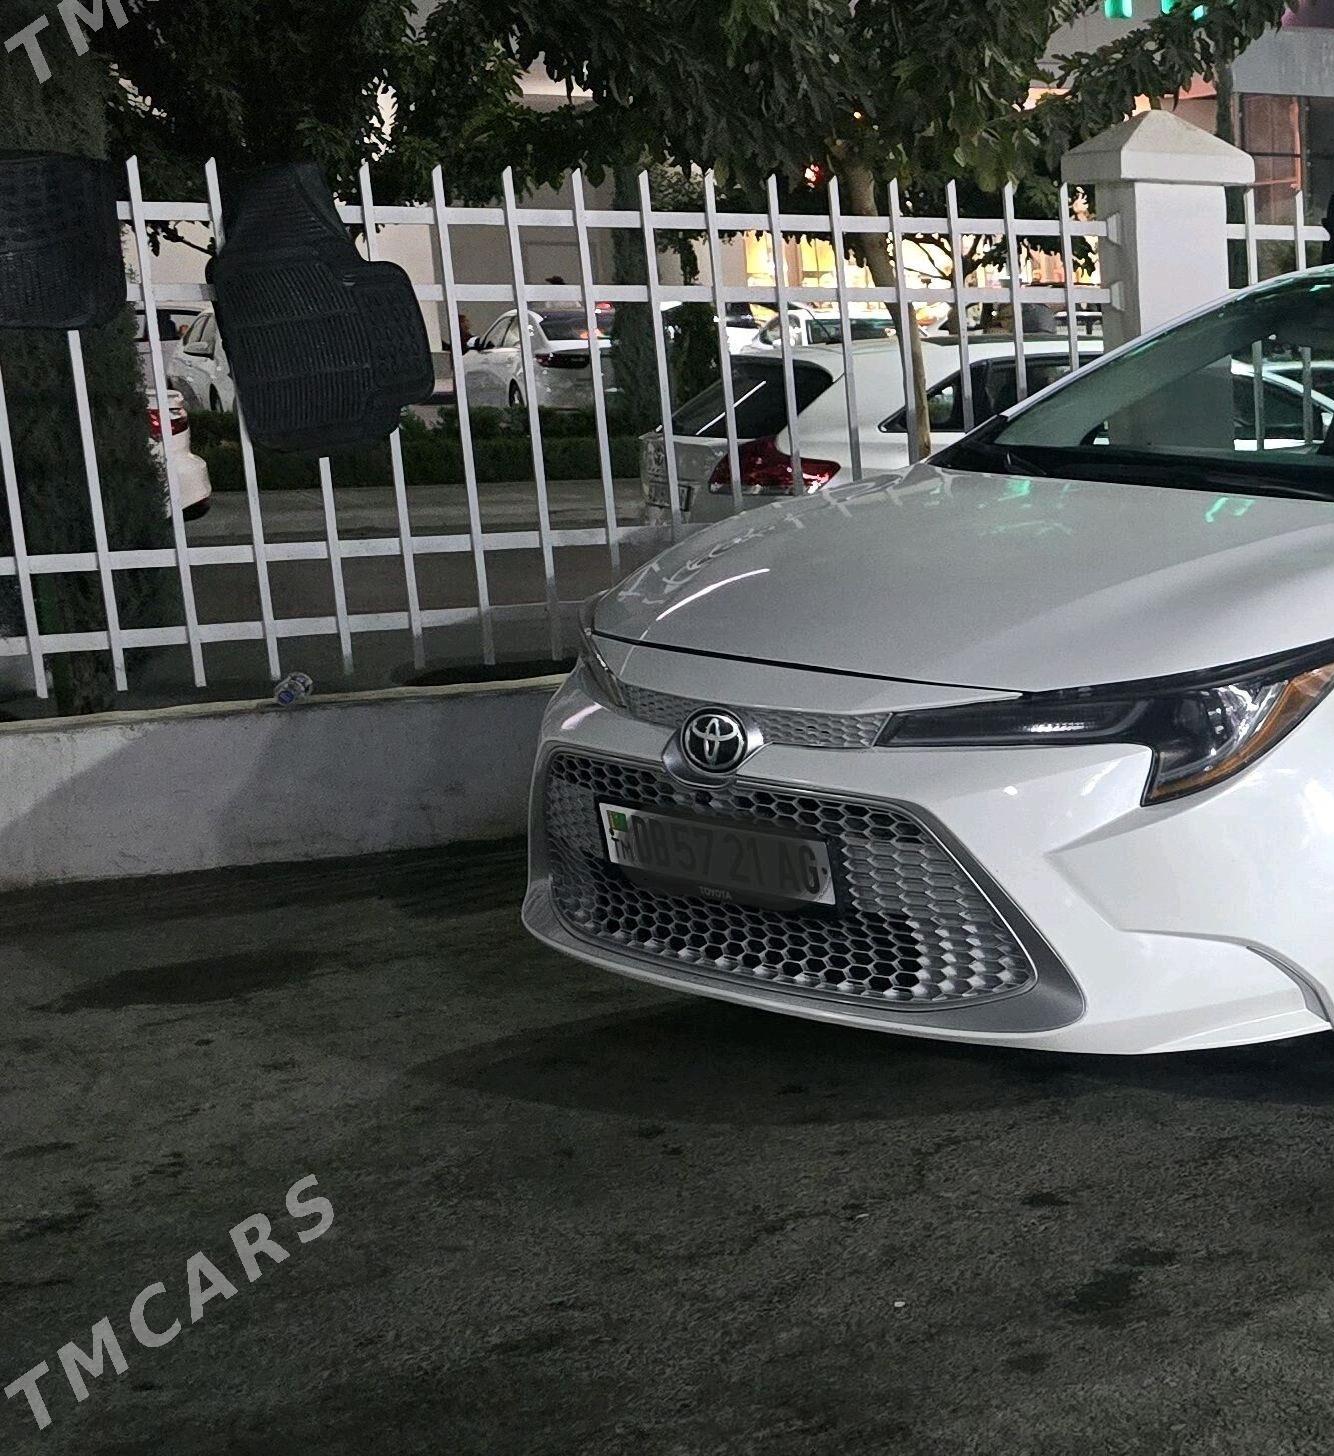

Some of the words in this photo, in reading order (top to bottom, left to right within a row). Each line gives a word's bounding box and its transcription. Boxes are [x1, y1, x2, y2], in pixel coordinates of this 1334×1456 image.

[612, 837, 634, 861] TM
[777, 841, 821, 894] AG
[698, 885, 733, 900] TOYOTA
